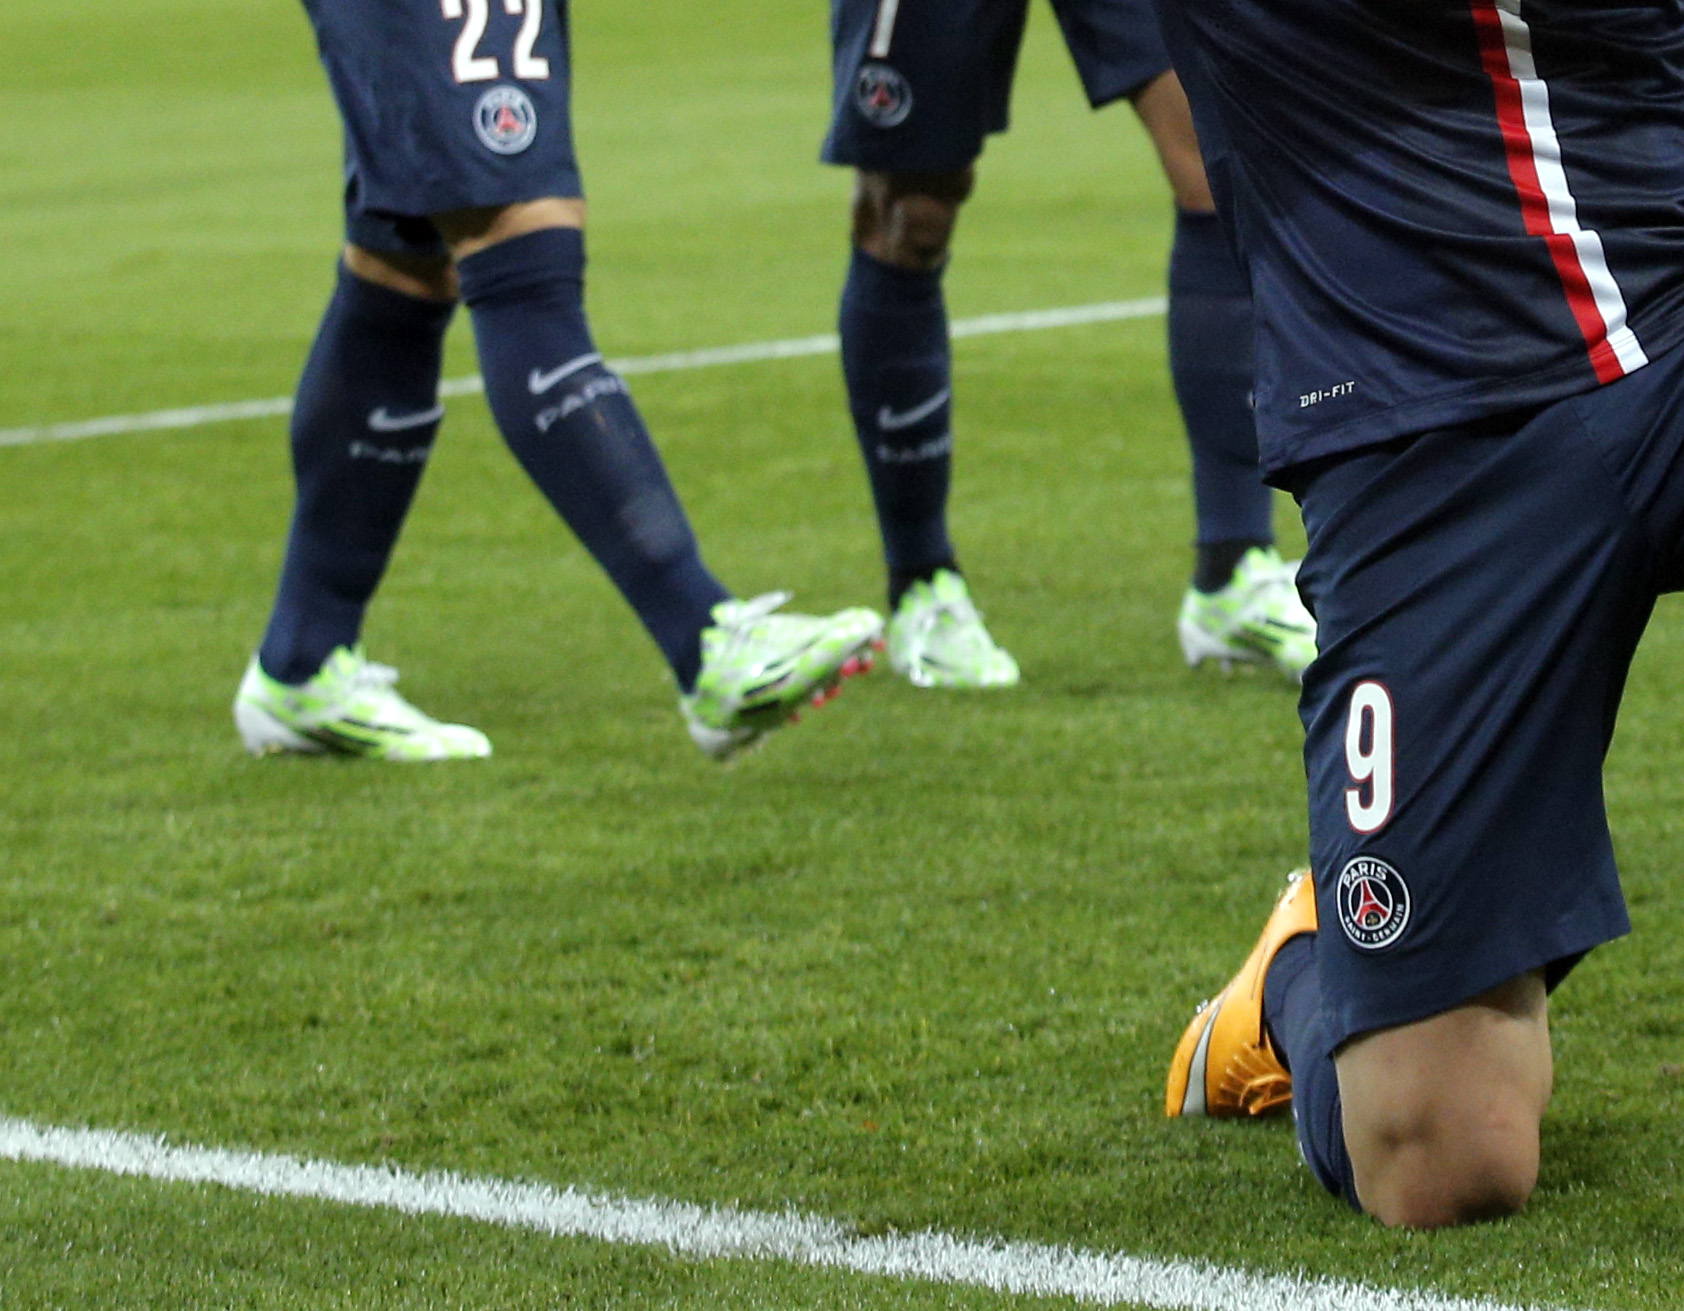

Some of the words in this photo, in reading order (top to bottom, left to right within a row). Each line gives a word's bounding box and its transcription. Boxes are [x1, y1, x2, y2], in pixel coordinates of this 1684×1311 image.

[1299, 380, 1355, 408] DRI-FIT
[1345, 679, 1395, 835] 9
[1342, 861, 1388, 888] PARIS
